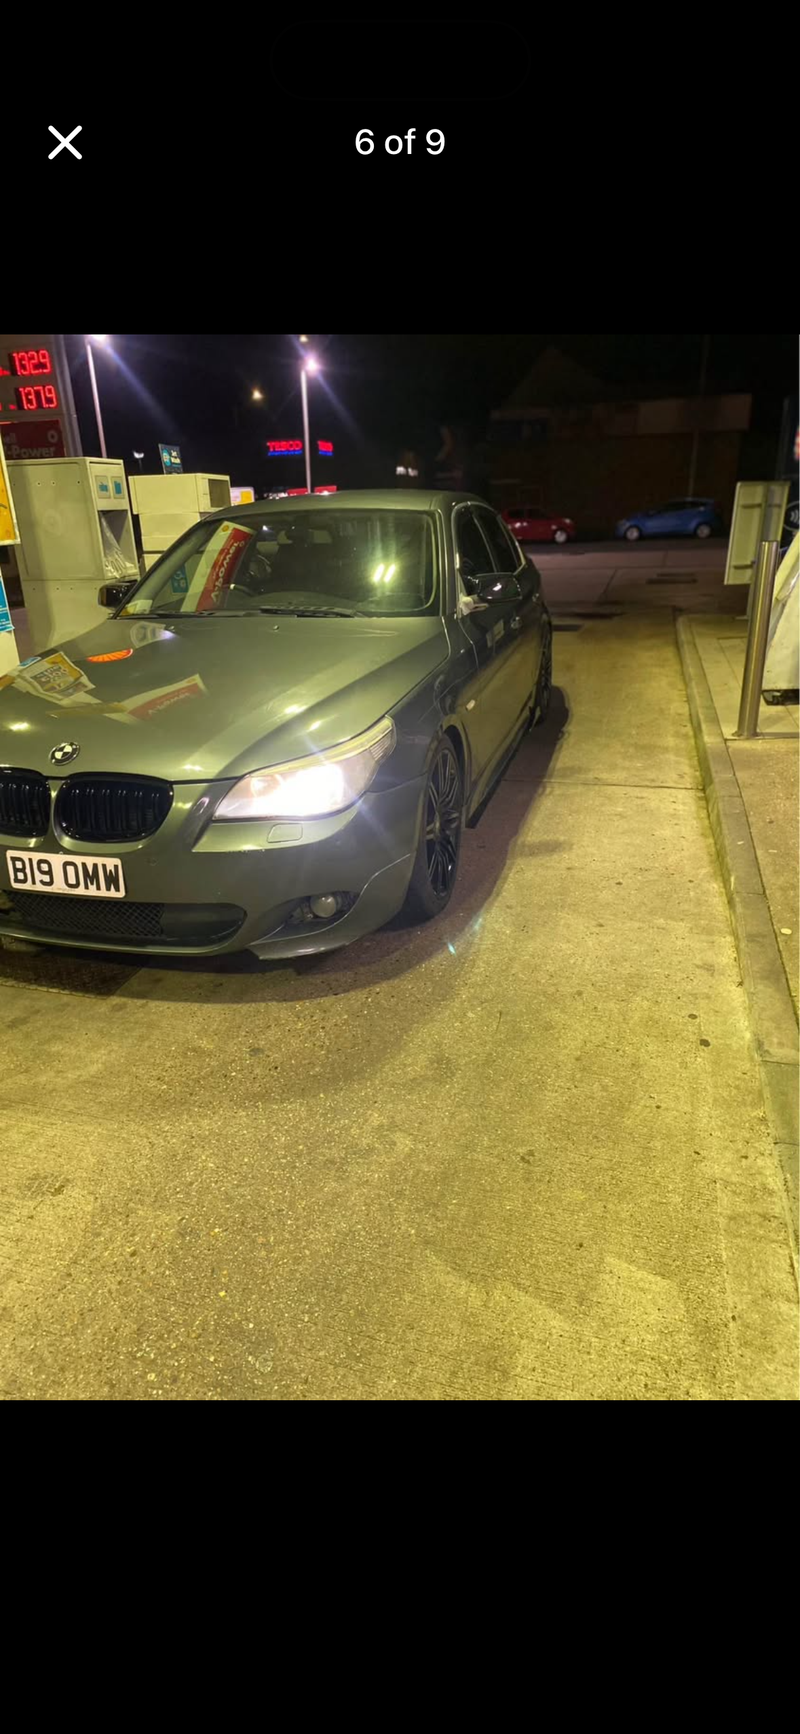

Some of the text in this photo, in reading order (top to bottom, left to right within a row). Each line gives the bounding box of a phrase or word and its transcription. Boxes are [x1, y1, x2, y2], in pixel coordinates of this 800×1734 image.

[6, 445, 55, 458] -Power
[267, 440, 303, 452] TESCO
[10, 856, 120, 892] B19 OMW
